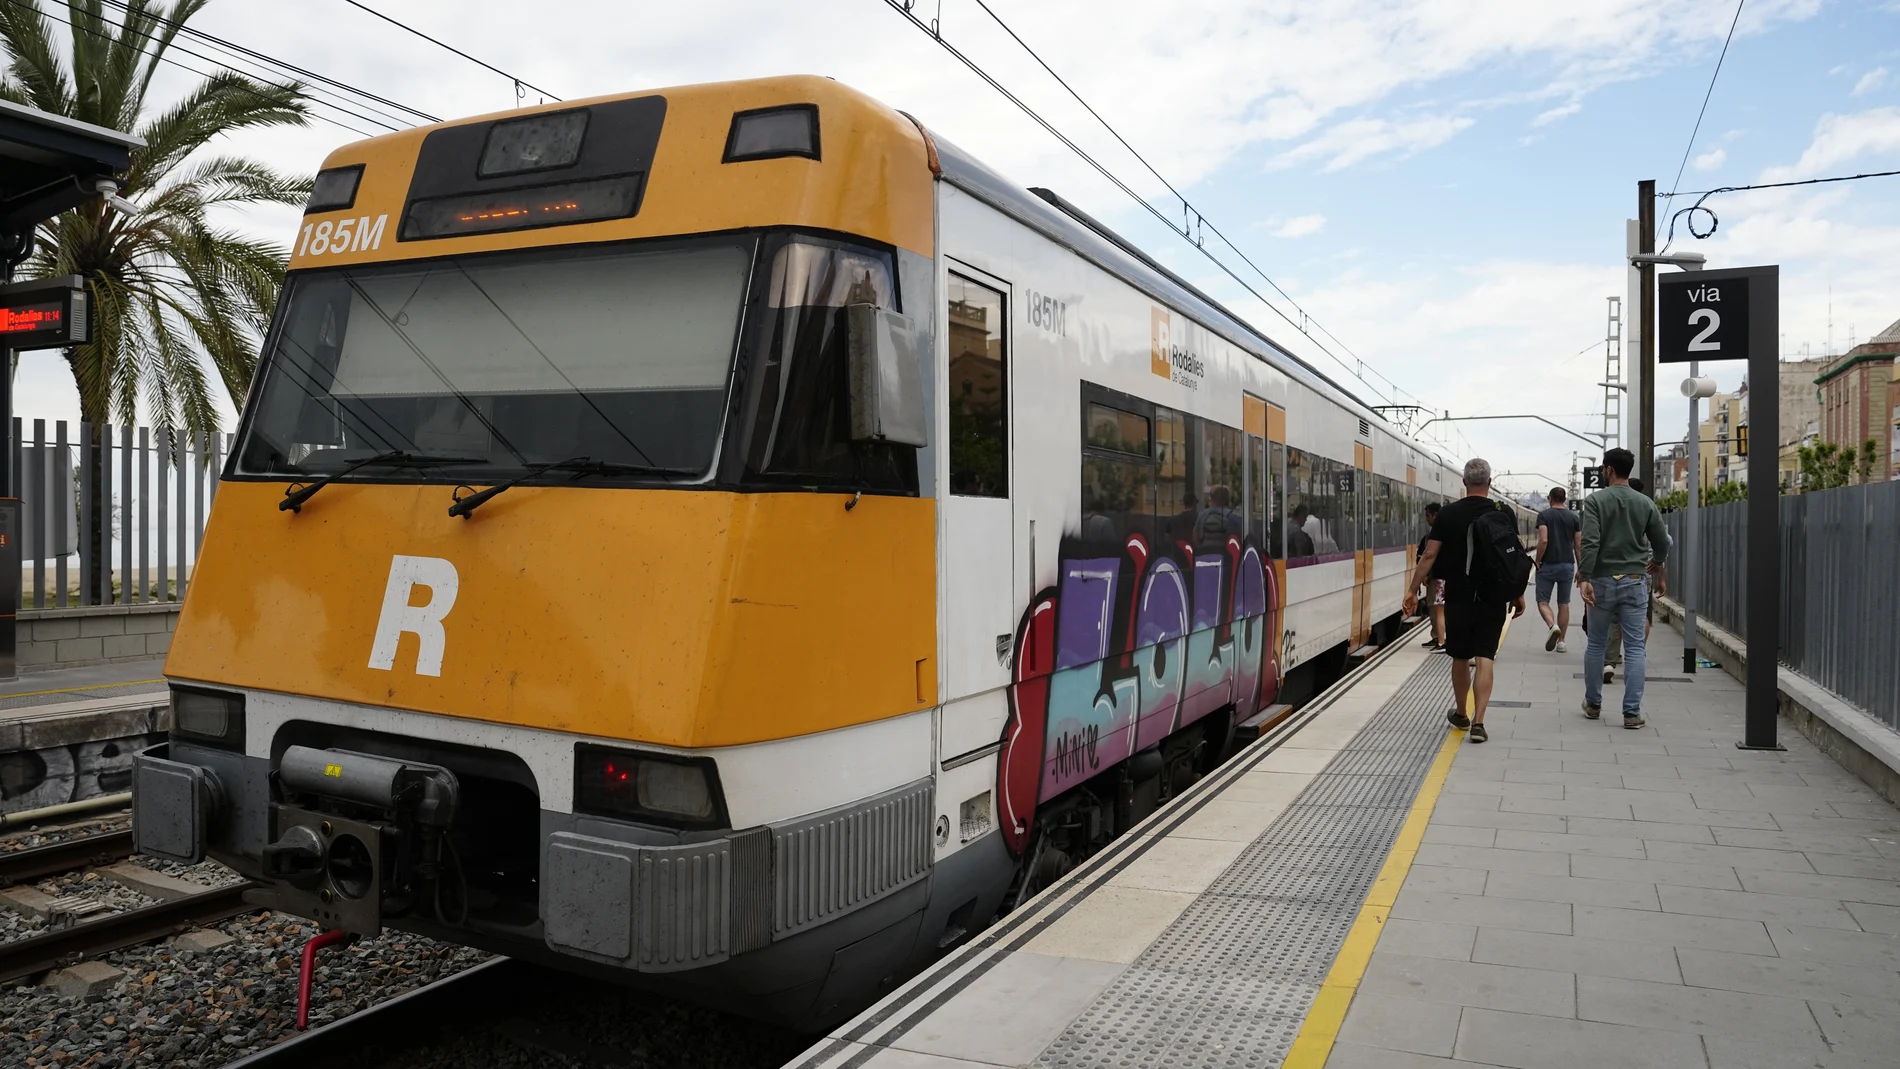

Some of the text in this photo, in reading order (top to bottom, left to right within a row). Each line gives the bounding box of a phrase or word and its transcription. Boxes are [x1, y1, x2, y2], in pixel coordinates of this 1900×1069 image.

[299, 214, 388, 257] 185M
[1025, 288, 1066, 337] 185M
[1687, 284, 1721, 303] via
[9, 310, 43, 324] Rodalies
[1687, 308, 1721, 352] 2
[1172, 344, 1205, 379] Rodalies
[1590, 475, 1599, 487] 2
[367, 554, 459, 677] R
